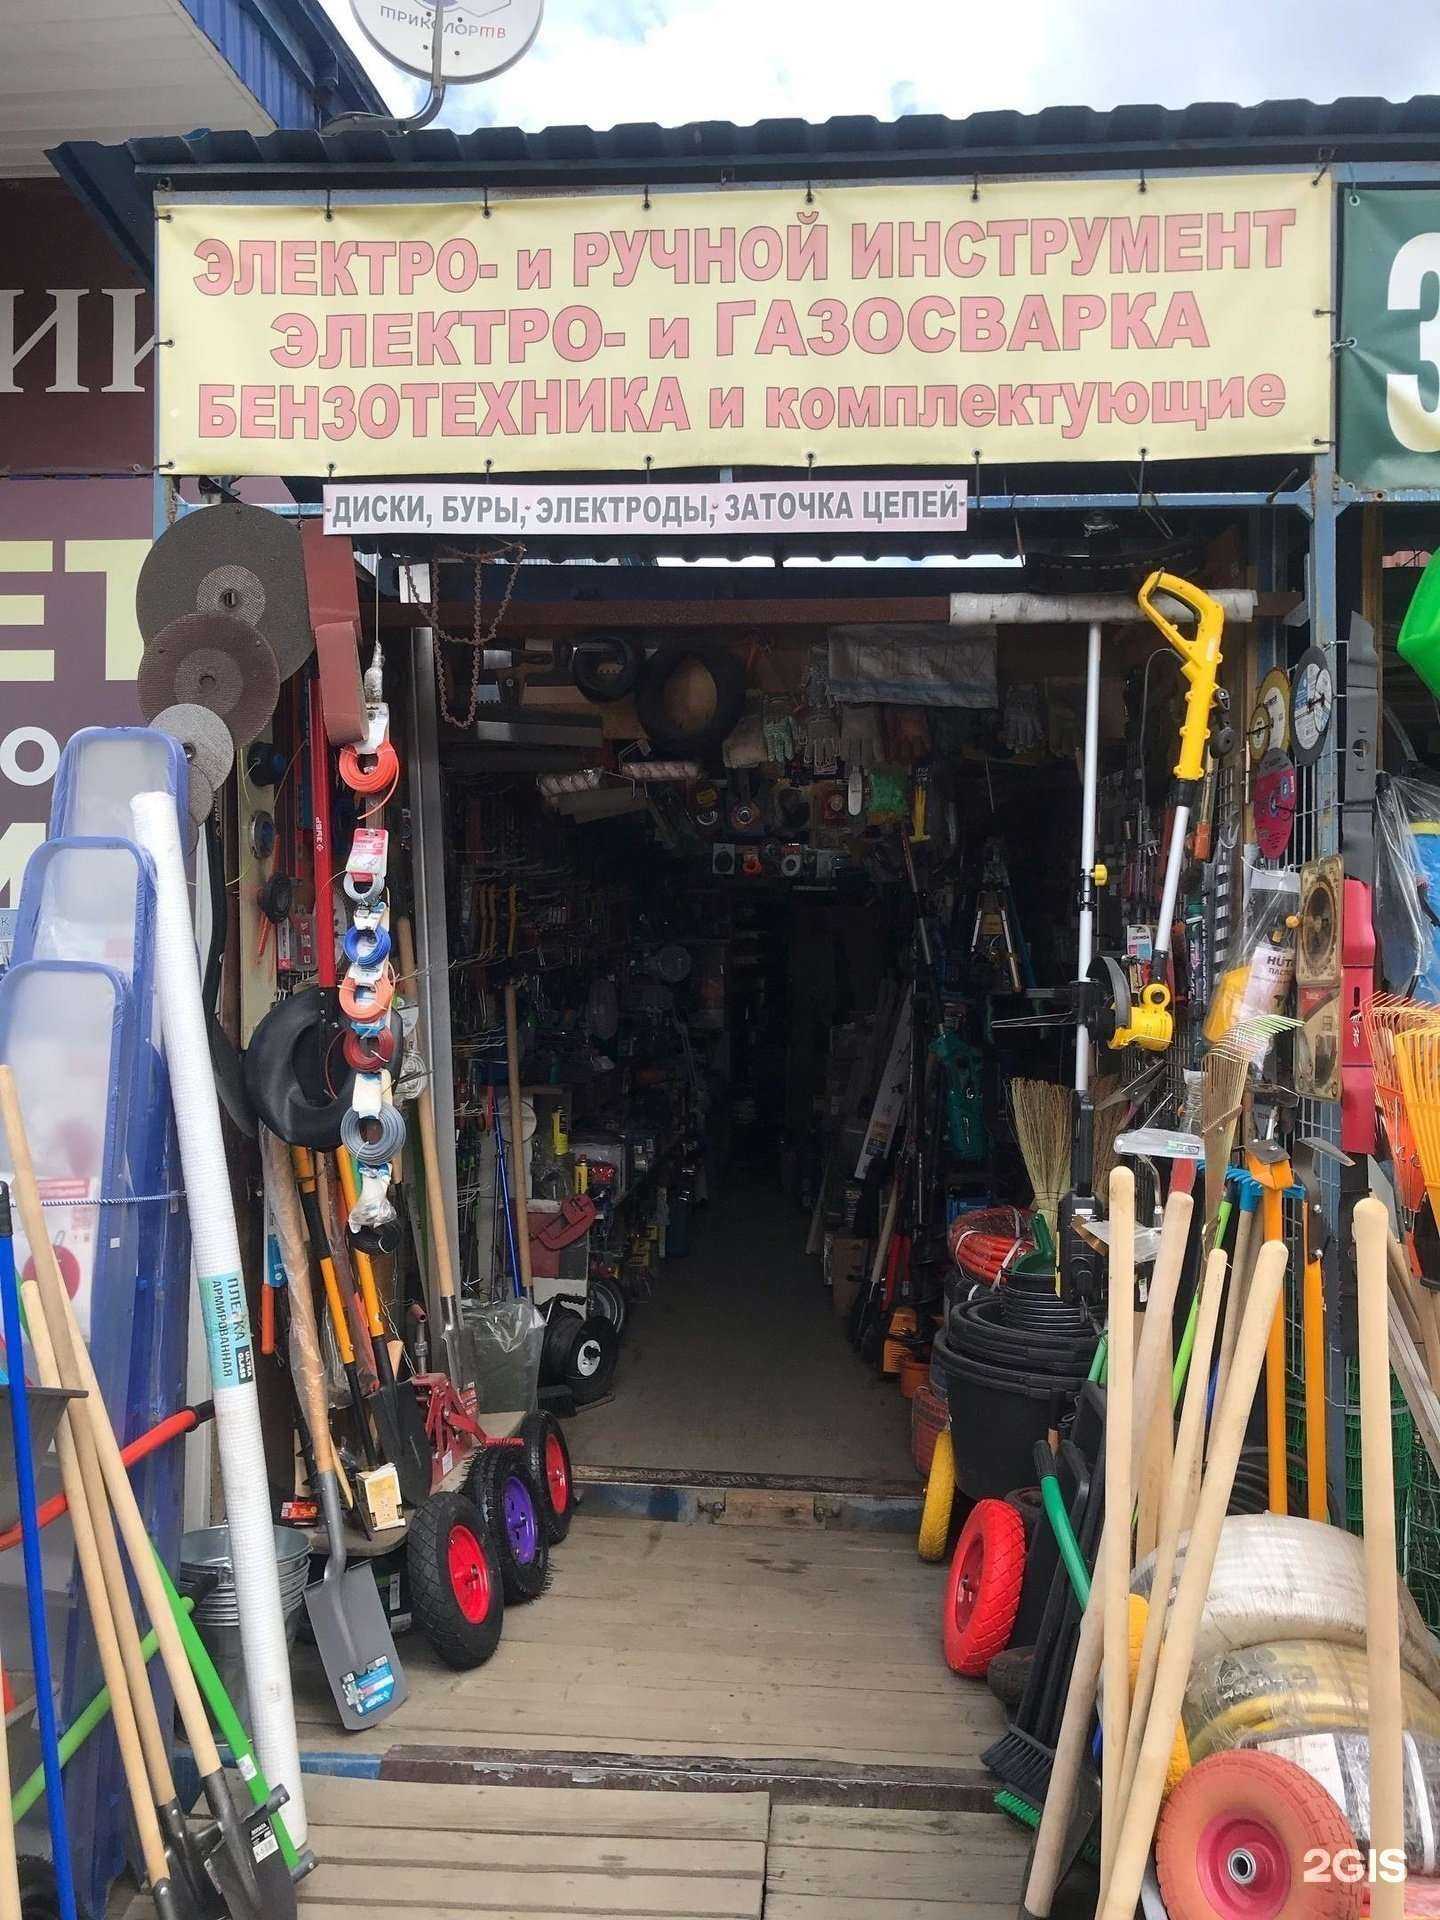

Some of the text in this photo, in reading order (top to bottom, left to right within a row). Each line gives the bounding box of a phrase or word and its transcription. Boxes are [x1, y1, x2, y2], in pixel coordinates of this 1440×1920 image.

[193, 208, 1297, 296] ЭЛЕКТРО- и РУЧНОЙ ИНСТРУМЕНТ
[270, 291, 1210, 369] ЭЛЕКТРО- и ГАЗОСВАРКА
[198, 373, 1286, 441] БЕНЗОТЕХНИКА и комплектующие
[332, 483, 958, 530] ДИСКИ, БУРЫ, ЭЛЕКТРОДЫ, ЗАТОЧКА ЦЕПЕЙ
[212, 1280, 233, 1377] АРМИРОВАННАЯ
